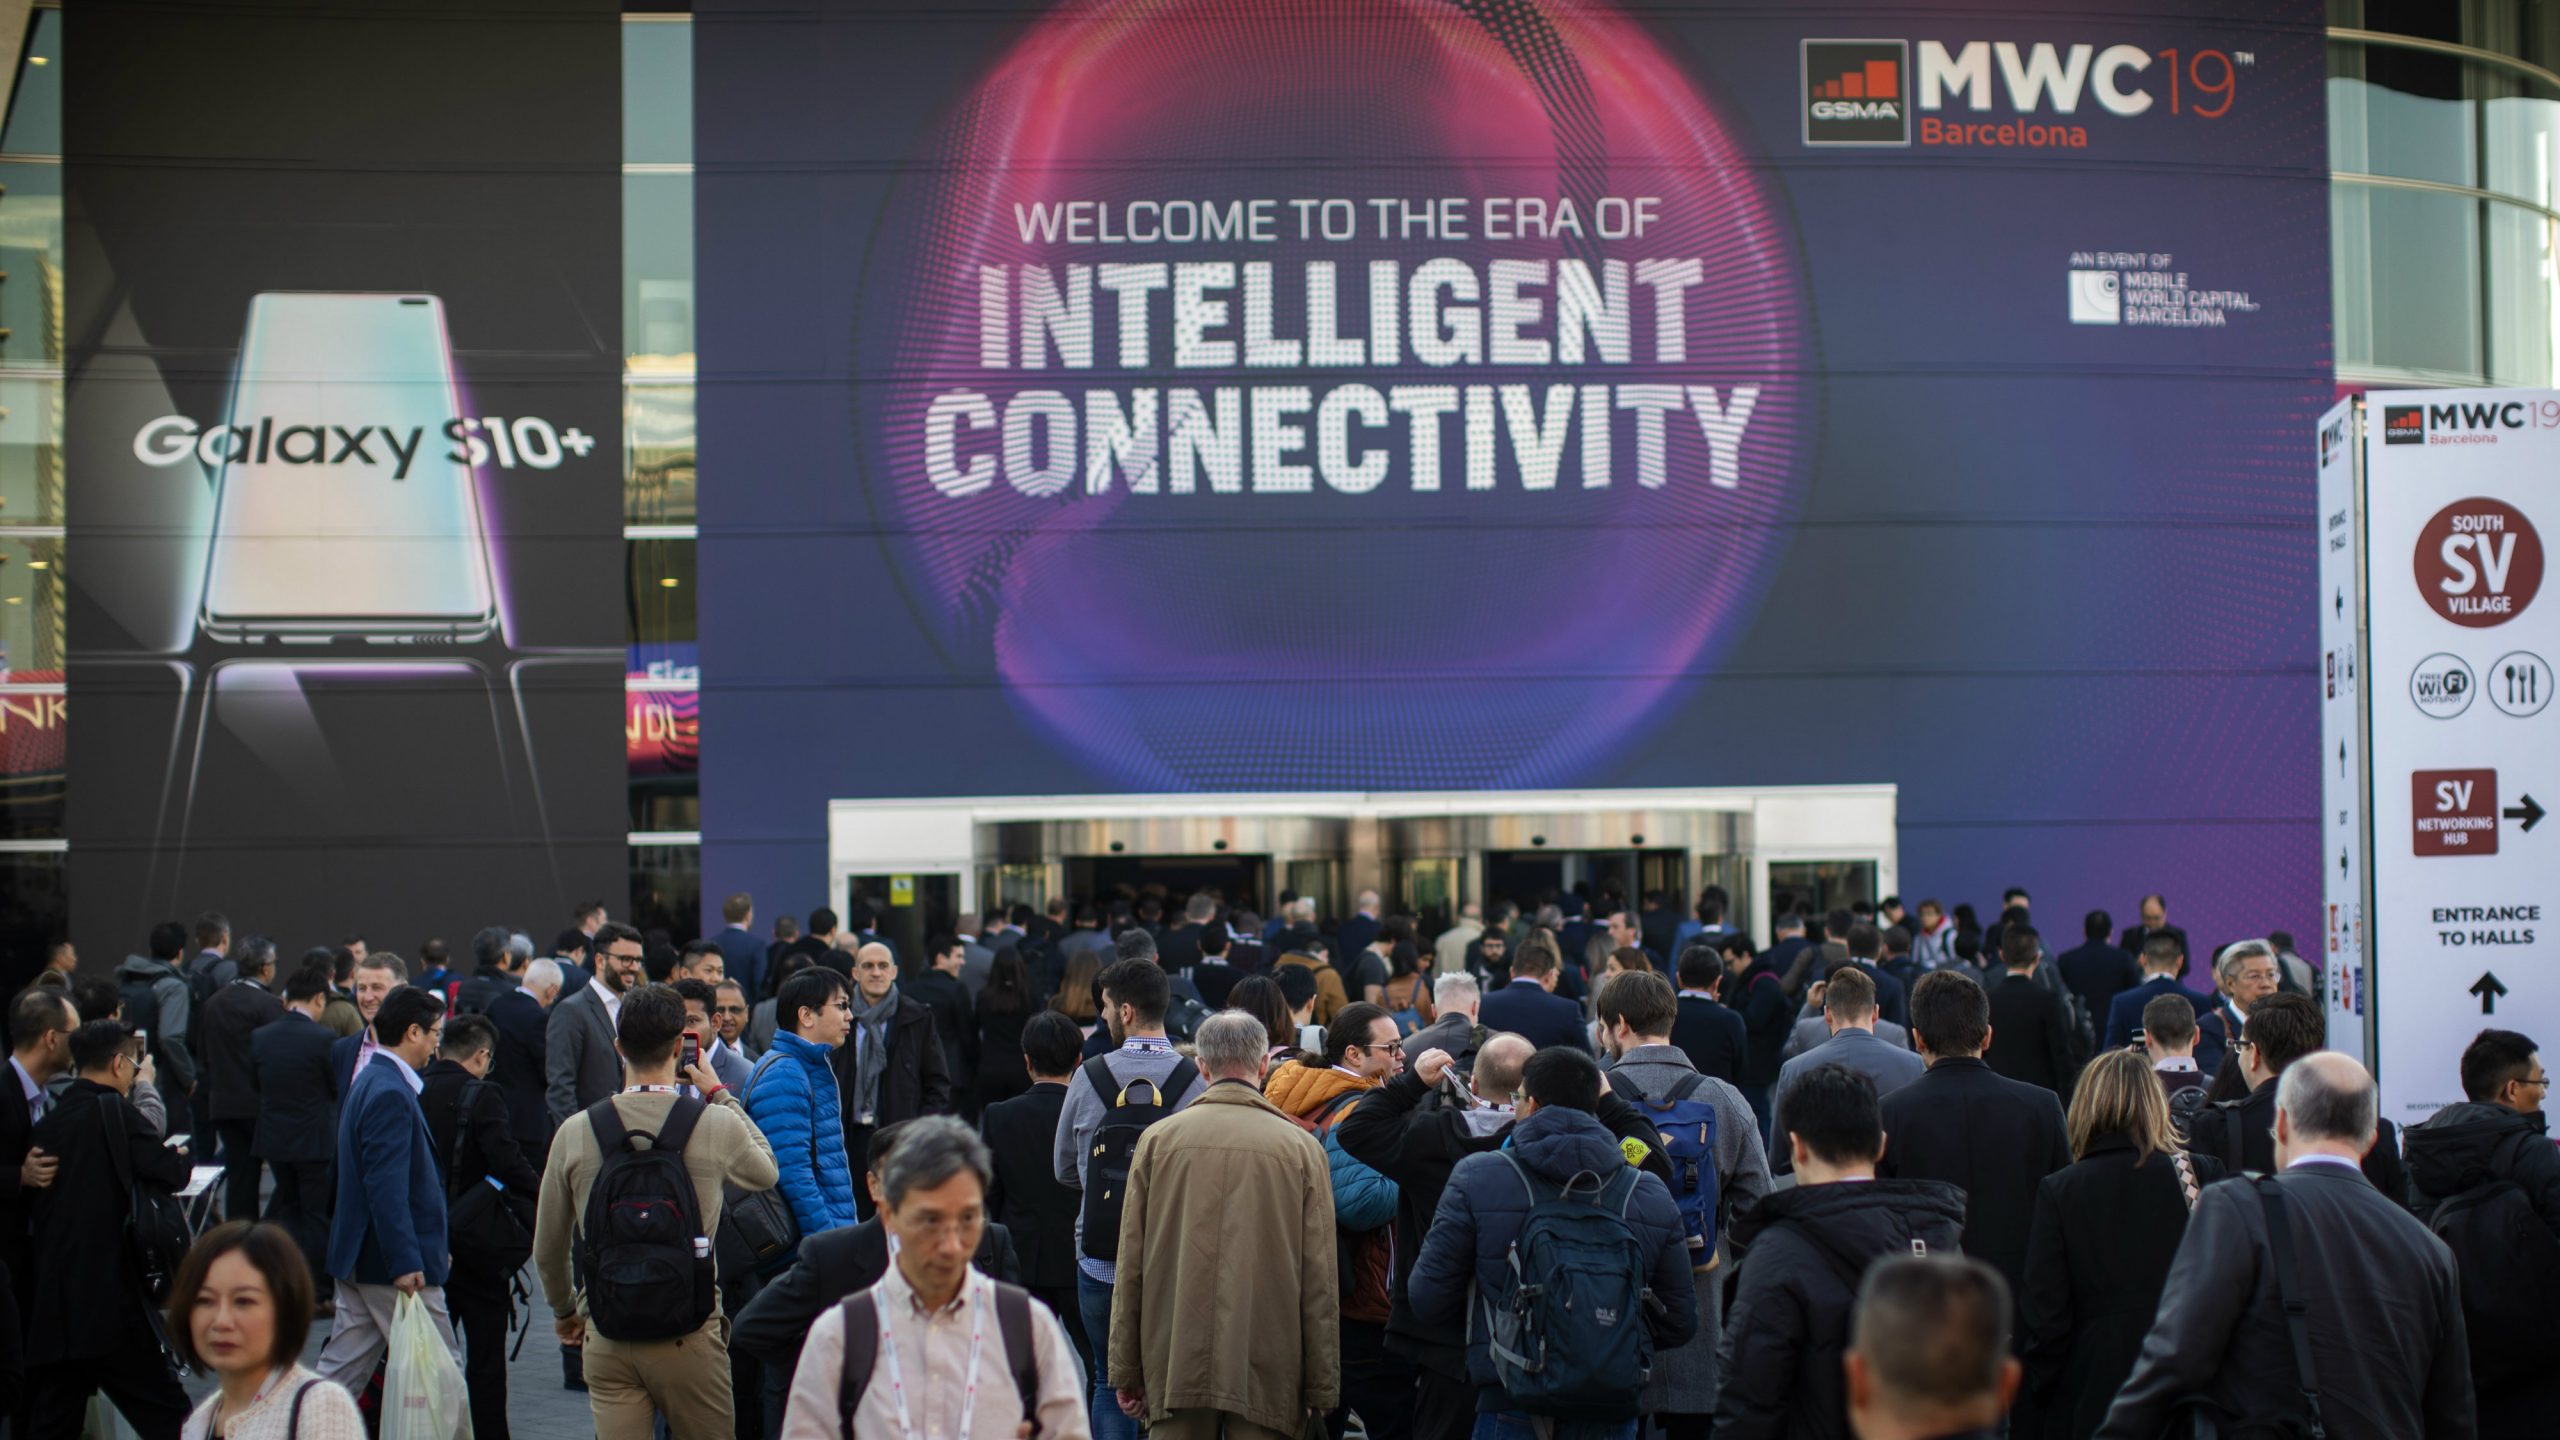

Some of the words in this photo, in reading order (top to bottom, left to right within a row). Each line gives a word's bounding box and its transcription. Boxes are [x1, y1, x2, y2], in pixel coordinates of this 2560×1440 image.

[1810, 101, 1899, 120] GSMA
[1921, 118, 2088, 148] Barcelona
[1014, 201, 1278, 244] WELCOME
[1289, 198, 1355, 241] TO
[1368, 198, 1469, 240] THE
[1484, 198, 1584, 240] ERA
[1596, 197, 1662, 239] OF
[2069, 252, 2095, 267] AN
[2098, 252, 2148, 268] EVENT
[2151, 253, 2173, 269] OF
[2125, 272, 2189, 290] MOBILE
[2126, 289, 2186, 307] WORLD
[979, 257, 1704, 369] INTELLIGENT
[2126, 307, 2227, 327] BARCELONA
[924, 383, 1760, 497] CONNECTIVITY
[2387, 427, 2422, 438] GSMA
[2430, 433, 2499, 445] Barcelona
[133, 415, 424, 480] Galaxy
[442, 416, 595, 469] S10+
[2452, 514, 2505, 533] SOUTH
[2440, 532, 2518, 596] SV
[2447, 596, 2513, 614] VILLAGE
[2435, 780, 2474, 812] SV
[2417, 815, 2495, 832] NETWORKING
[2442, 832, 2469, 846] HUB
[2432, 904, 2541, 923] ENTRANCE
[2439, 930, 2466, 946] TO
[2470, 928, 2536, 945] HALLS
